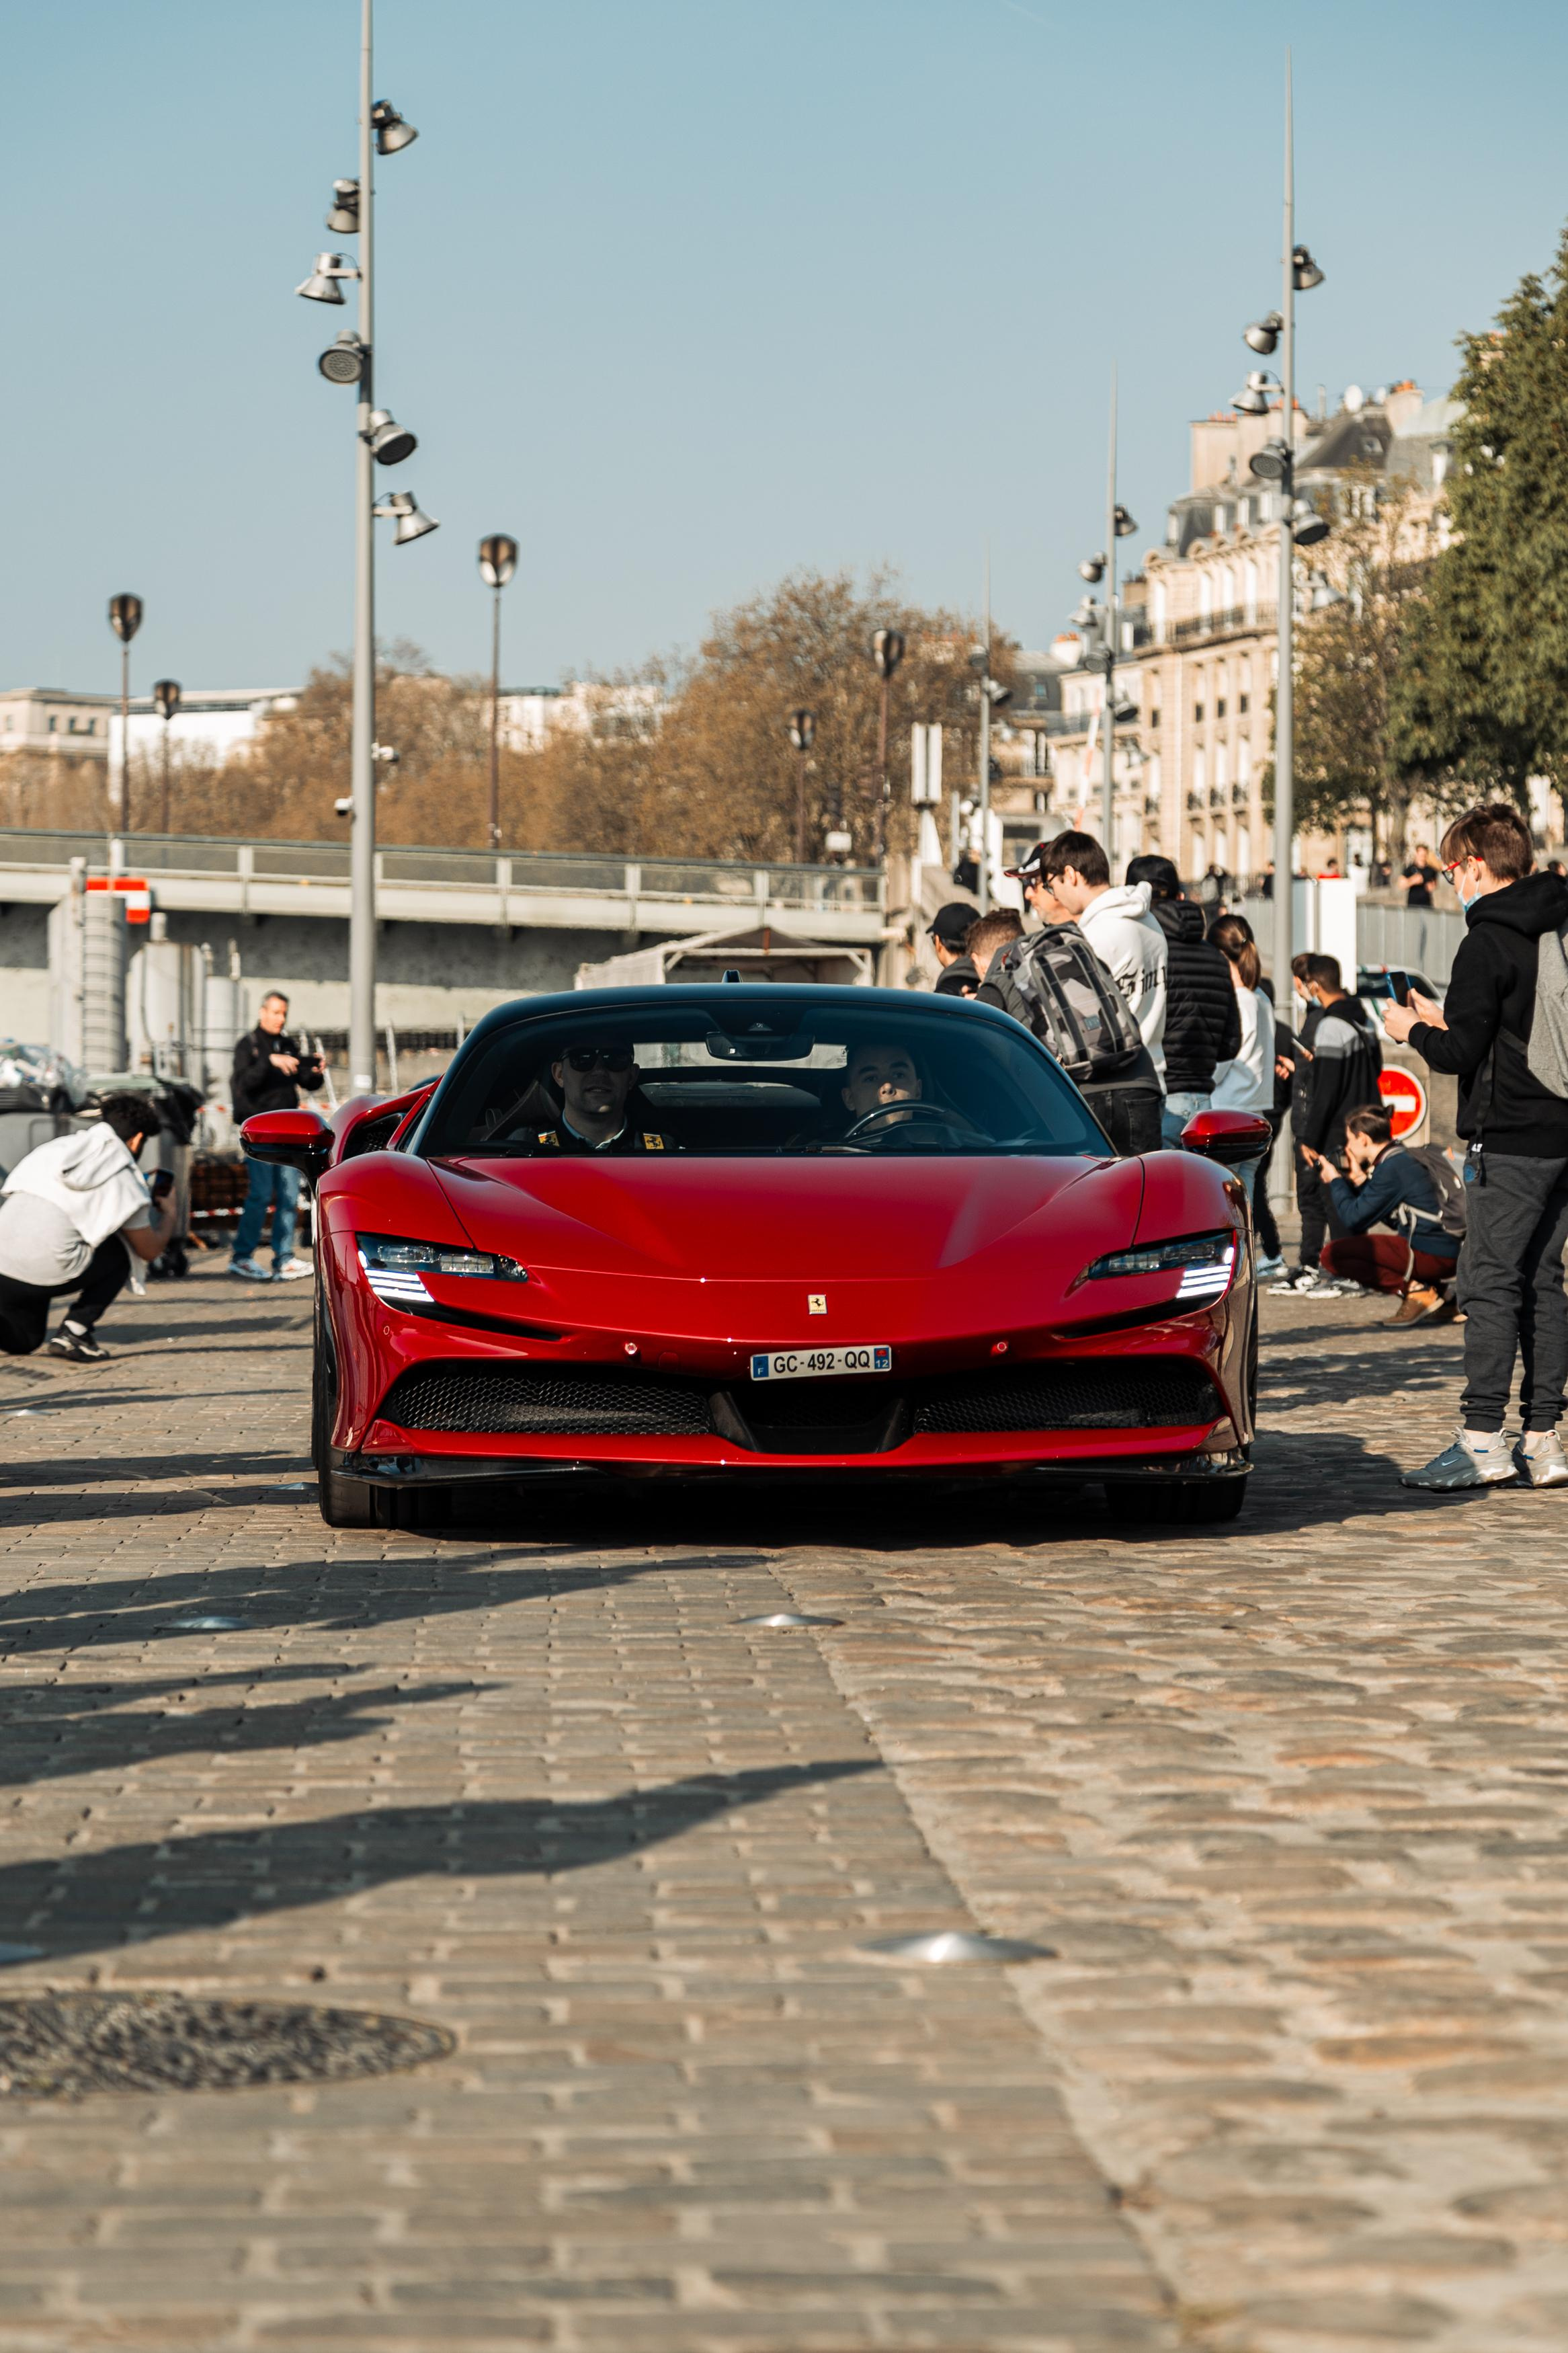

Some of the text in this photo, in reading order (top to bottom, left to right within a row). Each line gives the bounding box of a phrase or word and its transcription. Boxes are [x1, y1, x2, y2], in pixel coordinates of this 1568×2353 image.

[774, 1350, 870, 1373] GC-492-QQ
[876, 1359, 889, 1368] 12
[757, 1367, 764, 1375] F
